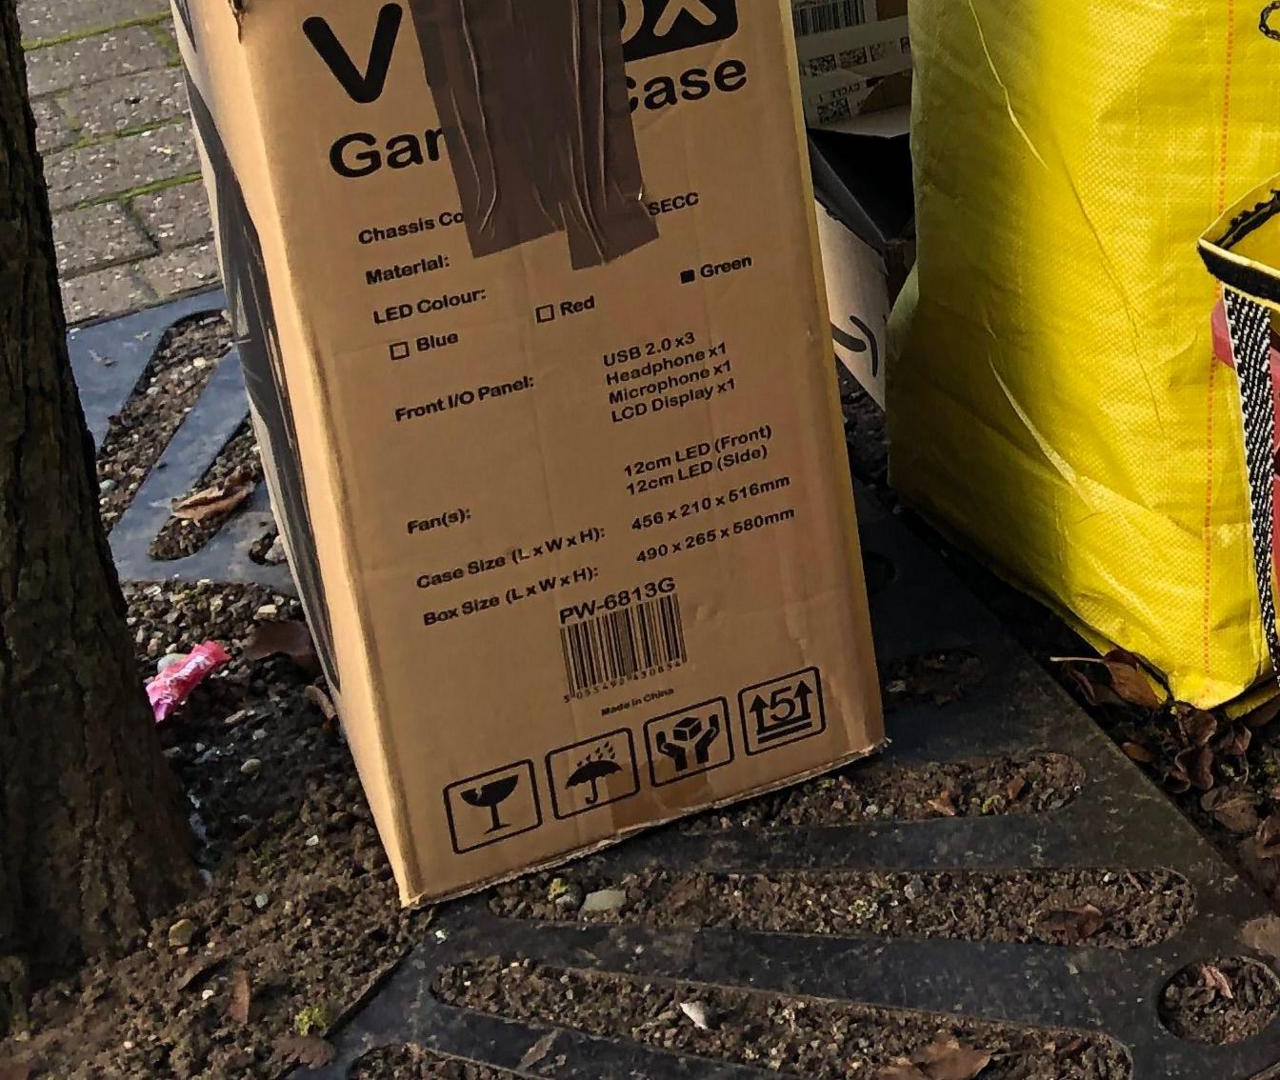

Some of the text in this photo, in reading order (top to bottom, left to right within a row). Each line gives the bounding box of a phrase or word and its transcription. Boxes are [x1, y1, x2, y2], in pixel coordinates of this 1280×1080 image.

[647, 191, 700, 217] SECC
[358, 211, 465, 245] Chassis Co
[365, 255, 450, 286] Material:
[699, 255, 753, 279] Green
[373, 288, 487, 325] LED Colour:
[559, 296, 596, 317] Red
[416, 331, 460, 353] Blue
[602, 331, 696, 368] USB 2.0 x3
[605, 341, 728, 386] Headphone x1
[395, 375, 535, 422] Front I/O Panel:
[608, 360, 733, 405] Microphone x1
[611, 377, 737, 423] LCD Display x1
[623, 424, 773, 478] 12cm LED (Front)
[626, 444, 769, 496] 12cm LED (Side)
[407, 507, 472, 536] Fan(s):
[631, 476, 791, 532] 456 x 210 x 516mm
[416, 526, 606, 590] Case Size (L x W x H):
[636, 507, 796, 565] 490 x 265 x 580mm
[423, 565, 599, 627] Box Size (L x W x H):
[558, 576, 677, 625] PW-6813G
[601, 687, 675, 717] Made in China
